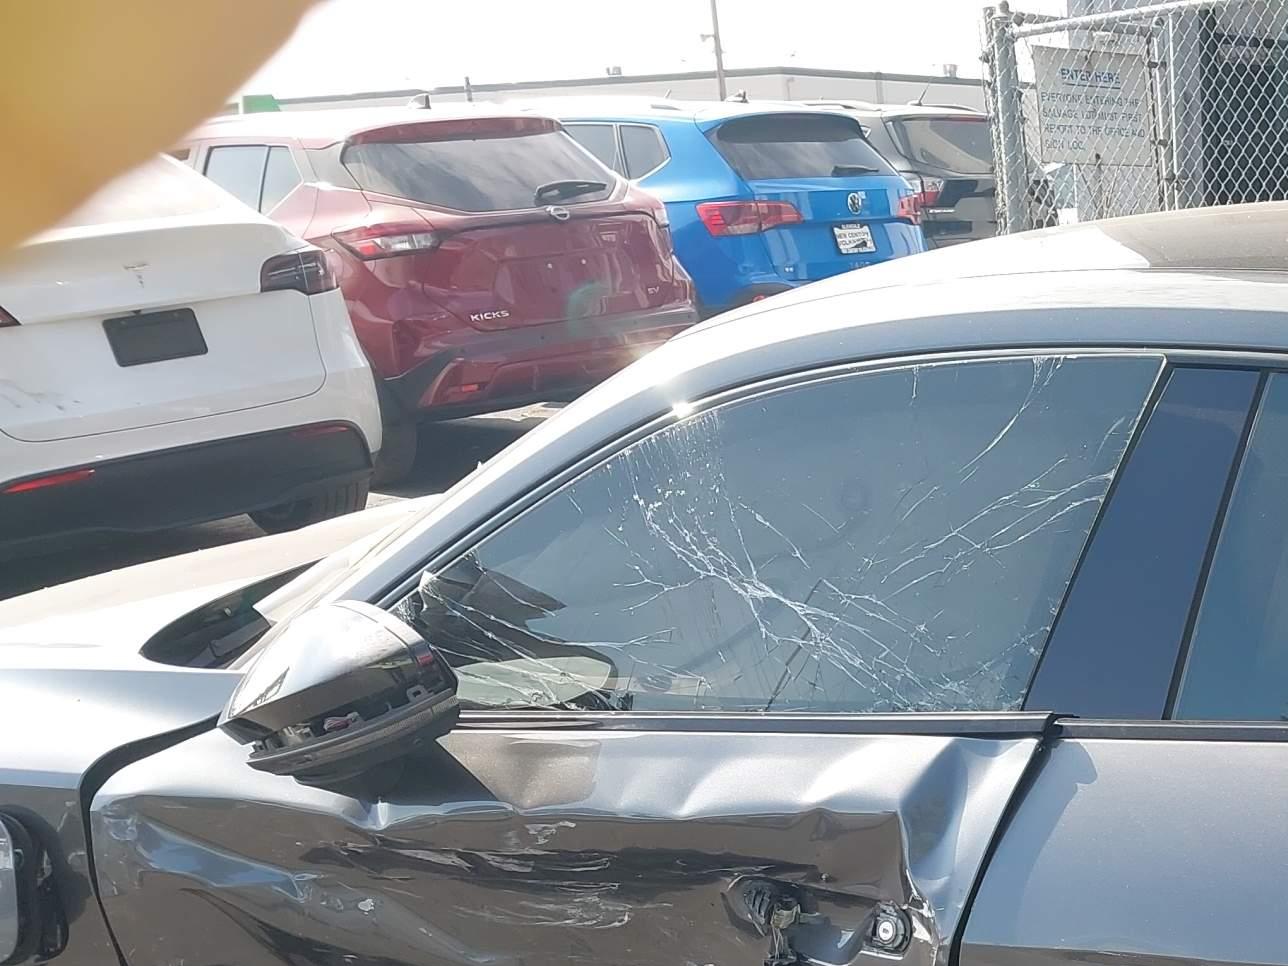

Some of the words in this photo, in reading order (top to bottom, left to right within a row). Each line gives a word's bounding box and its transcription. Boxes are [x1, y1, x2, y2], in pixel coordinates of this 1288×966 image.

[1060, 68, 1091, 82] ENTER
[1095, 71, 1121, 84] HERE
[1042, 107, 1078, 119] SALVAGE
[1076, 124, 1086, 135] TO
[470, 310, 510, 321] KICKS
